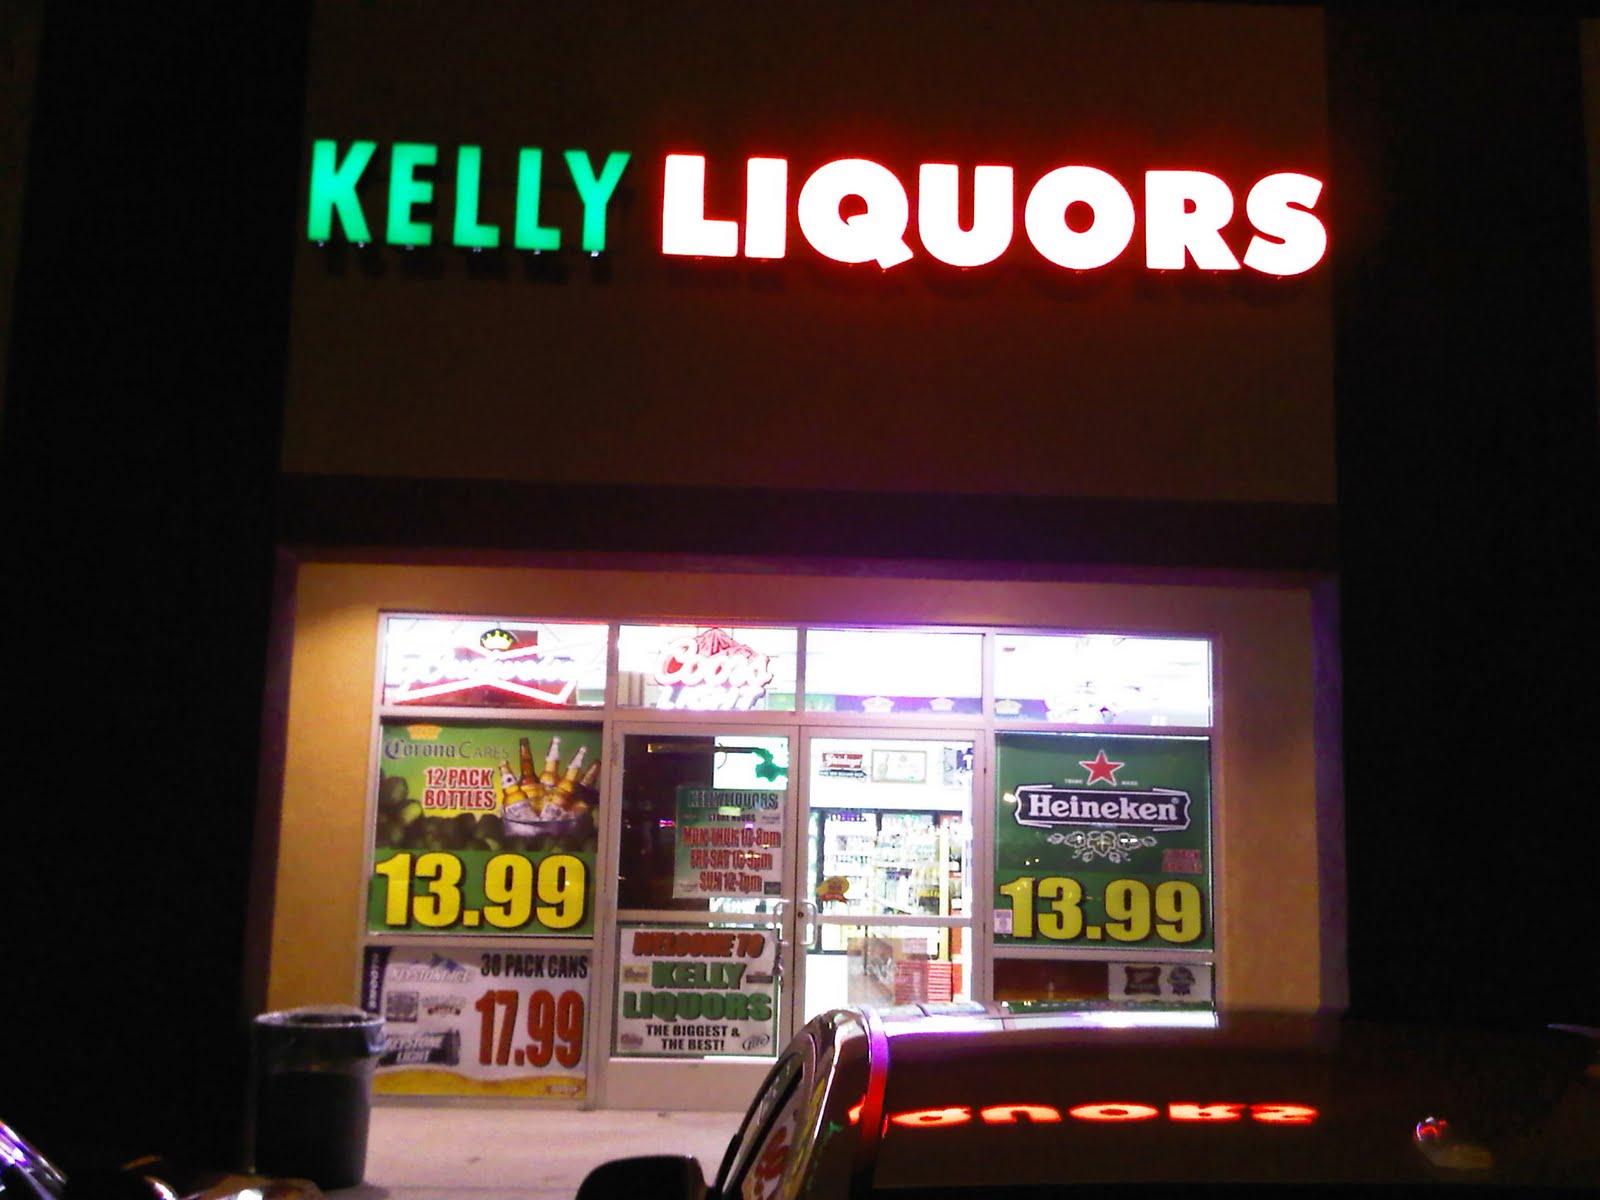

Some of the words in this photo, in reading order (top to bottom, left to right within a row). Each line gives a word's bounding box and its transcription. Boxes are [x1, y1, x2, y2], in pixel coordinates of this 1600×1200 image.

[307, 140, 631, 253] KELLY
[662, 154, 1327, 276] LIQUORS
[384, 739, 455, 760] Corona
[426, 767, 444, 788] 12
[447, 768, 493, 789] PACK
[424, 789, 497, 810] BOTTLES
[721, 792, 778, 811] LIQUORS
[1028, 793, 1178, 821] Heineken
[375, 851, 586, 930] 13.99
[700, 871, 723, 892] SUN
[1000, 876, 1201, 943] 13.99
[632, 931, 736, 957] WELCOME
[737, 932, 766, 958] TO
[480, 952, 501, 977] 30
[504, 953, 545, 978] PACK
[547, 954, 588, 979] CANS
[651, 960, 748, 990] KELLY
[622, 991, 773, 1022] LIQUORS
[475, 989, 585, 1068] 17.99
[645, 1024, 670, 1037] THE
[672, 1025, 729, 1037] BIGGEST
[731, 1026, 741, 1037] &
[661, 1038, 688, 1050] THE
[687, 1038, 726, 1051] BEST!
